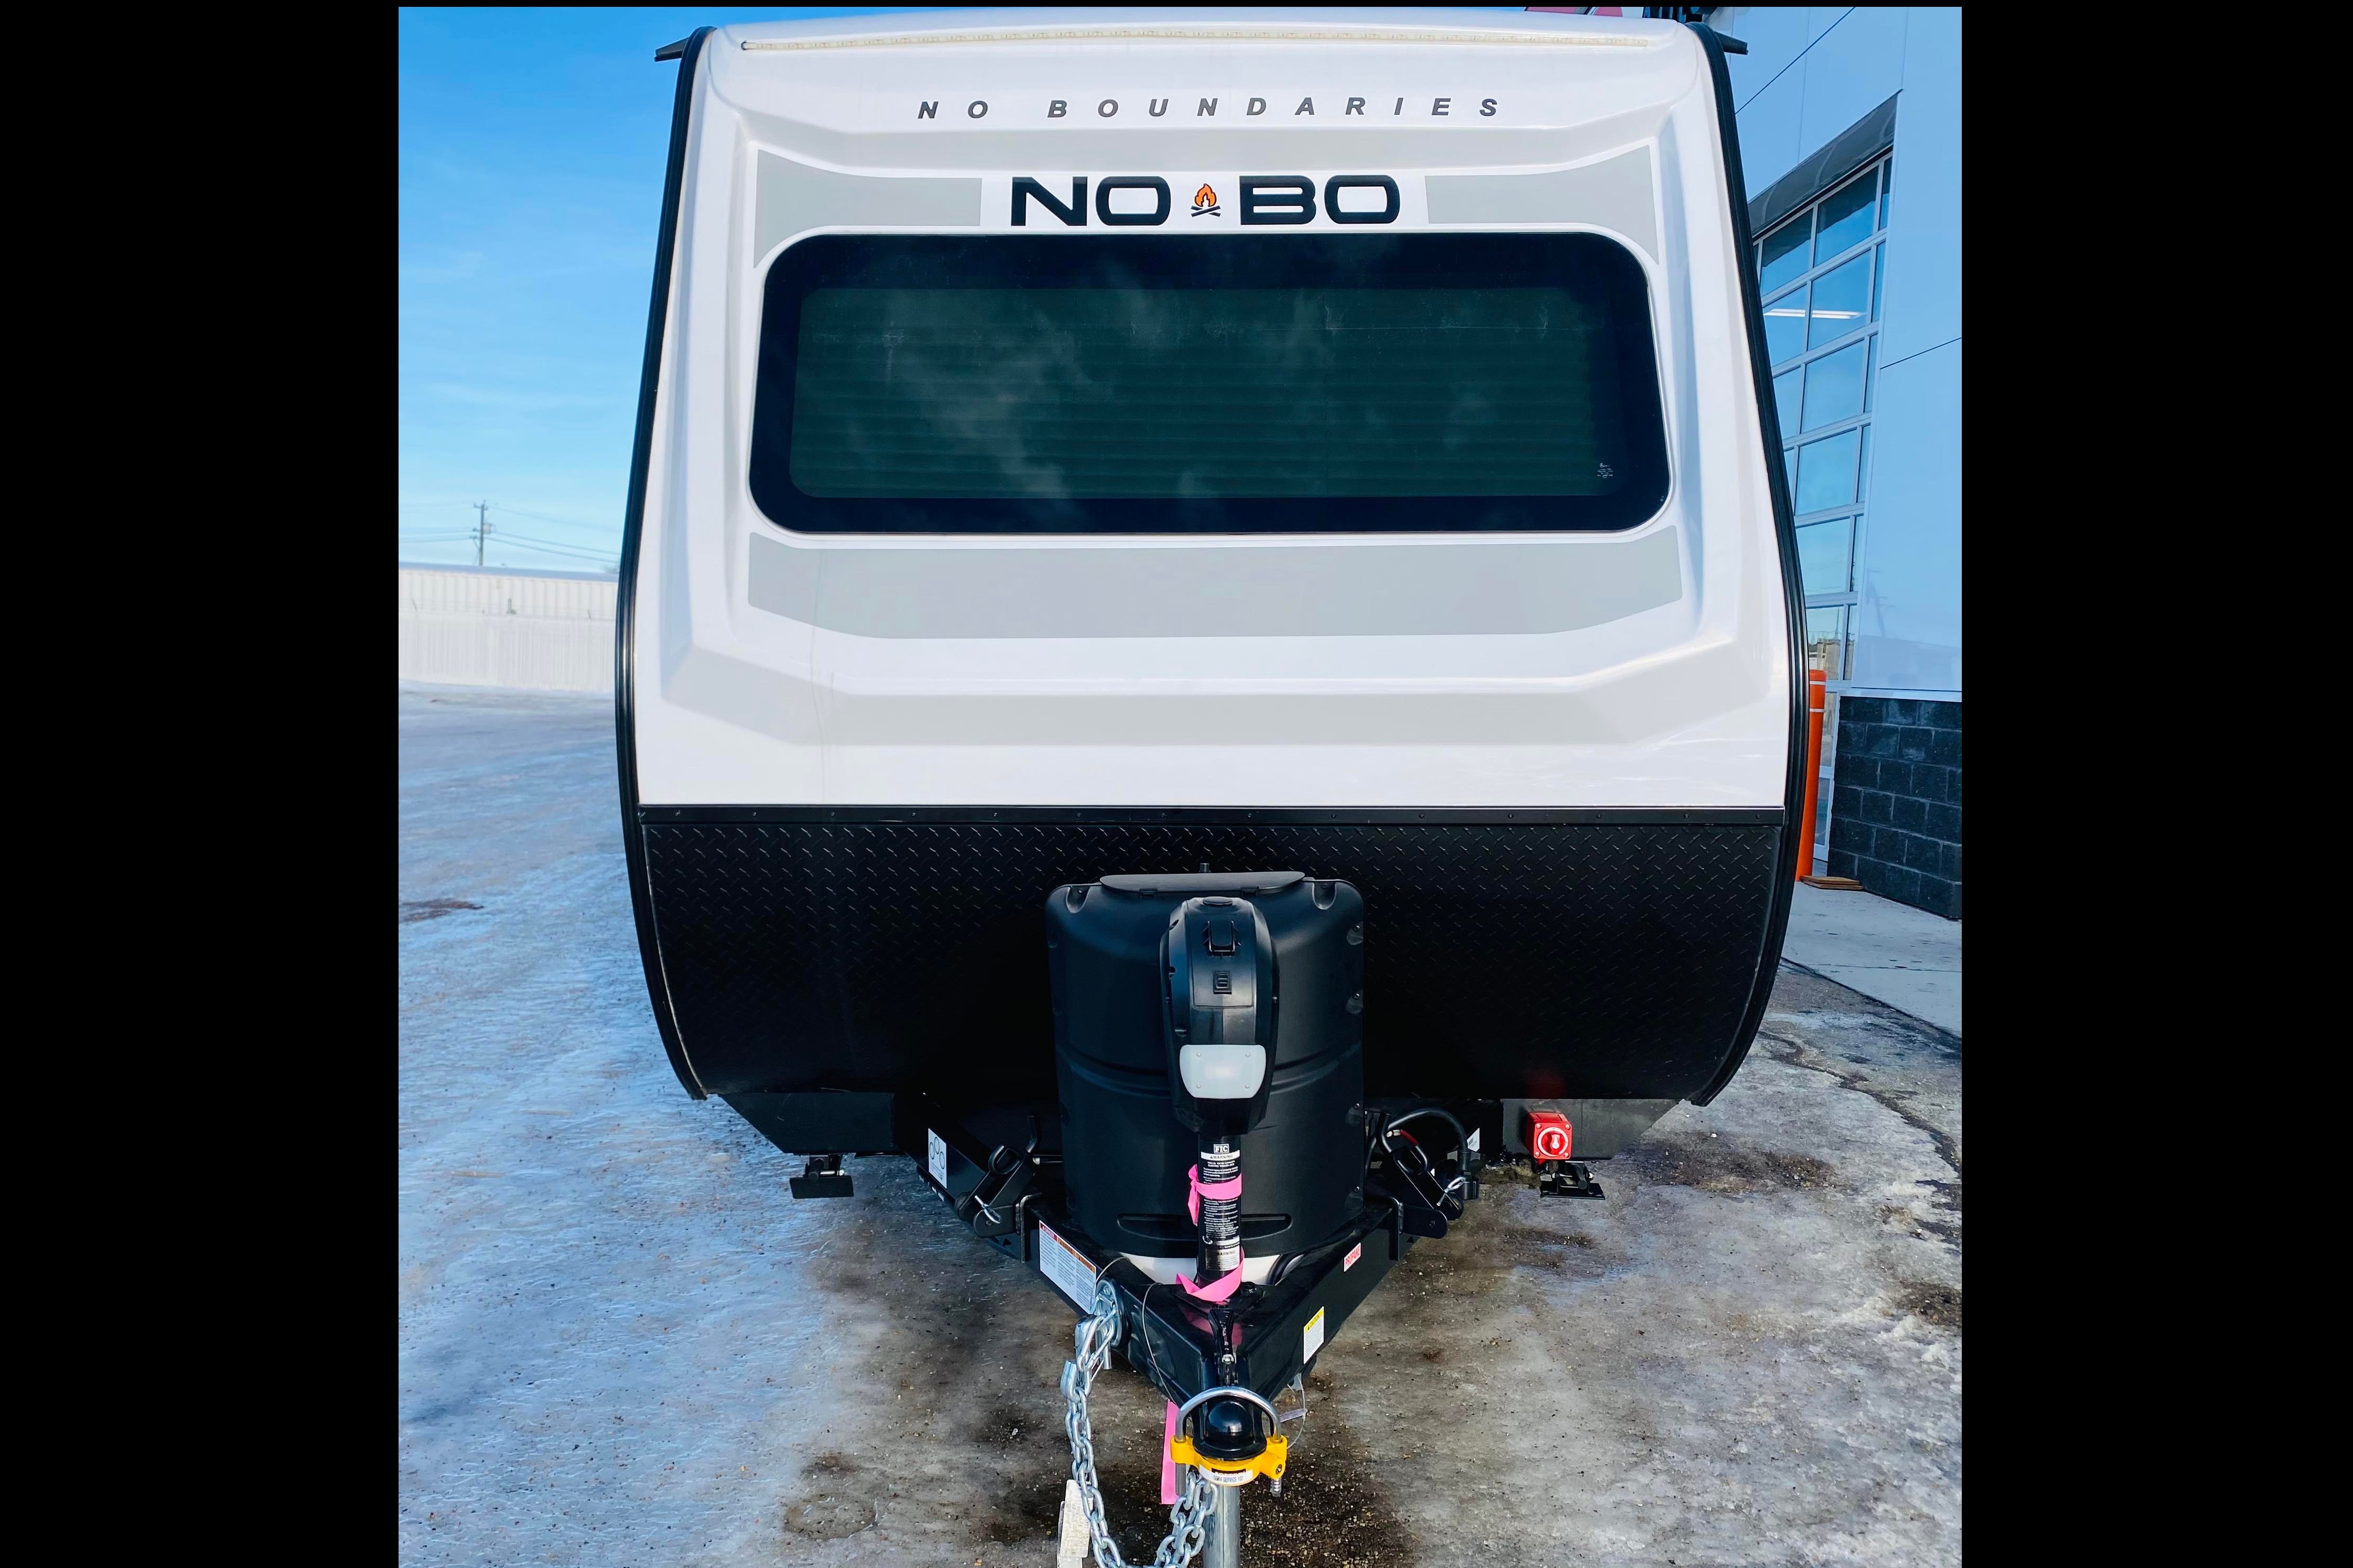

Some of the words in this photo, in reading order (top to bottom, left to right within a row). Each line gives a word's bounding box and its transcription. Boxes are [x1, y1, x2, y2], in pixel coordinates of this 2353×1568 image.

[917, 100, 989, 119] NO
[1046, 96, 1498, 118] BOUNDARIES
[1010, 176, 1172, 227] NO
[1238, 174, 1401, 226] BO
